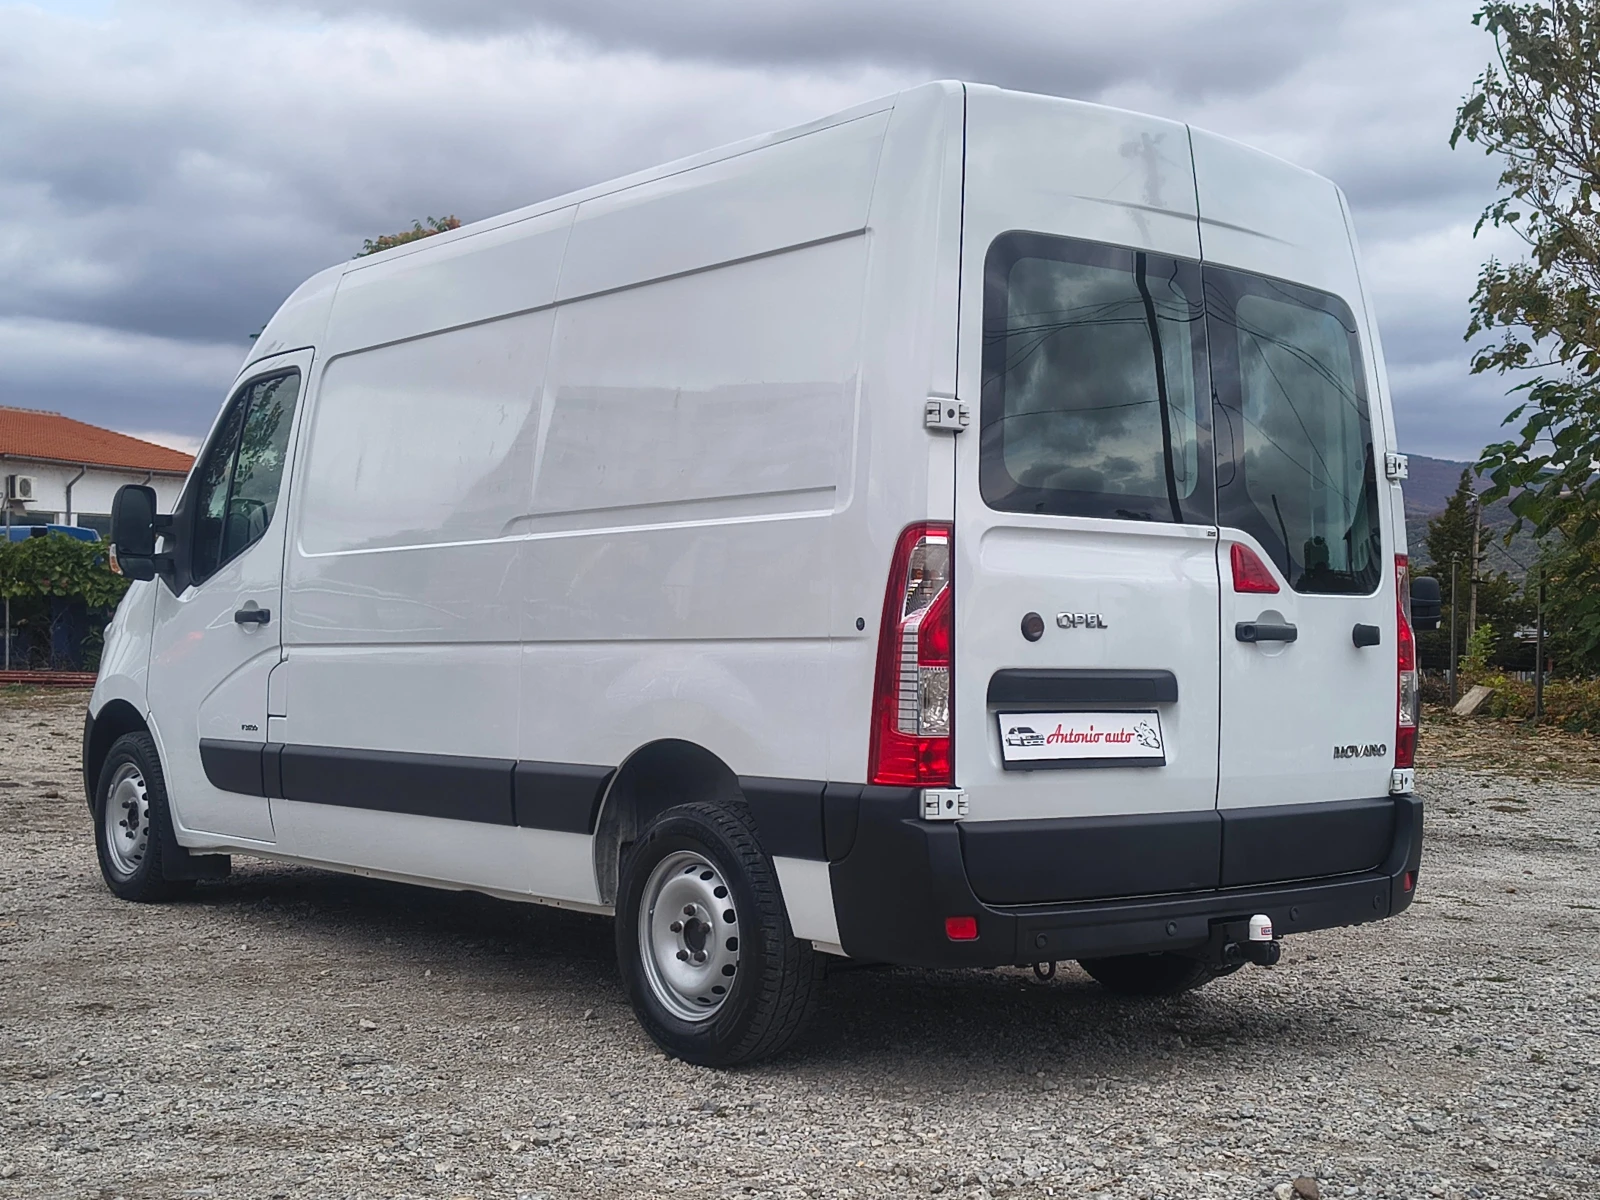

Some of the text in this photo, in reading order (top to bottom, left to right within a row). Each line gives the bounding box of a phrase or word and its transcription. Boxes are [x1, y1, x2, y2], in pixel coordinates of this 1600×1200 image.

[1056, 612, 1108, 629] OPEL
[1046, 724, 1135, 744] Antonio auto
[1333, 743, 1387, 759] MOVANO
